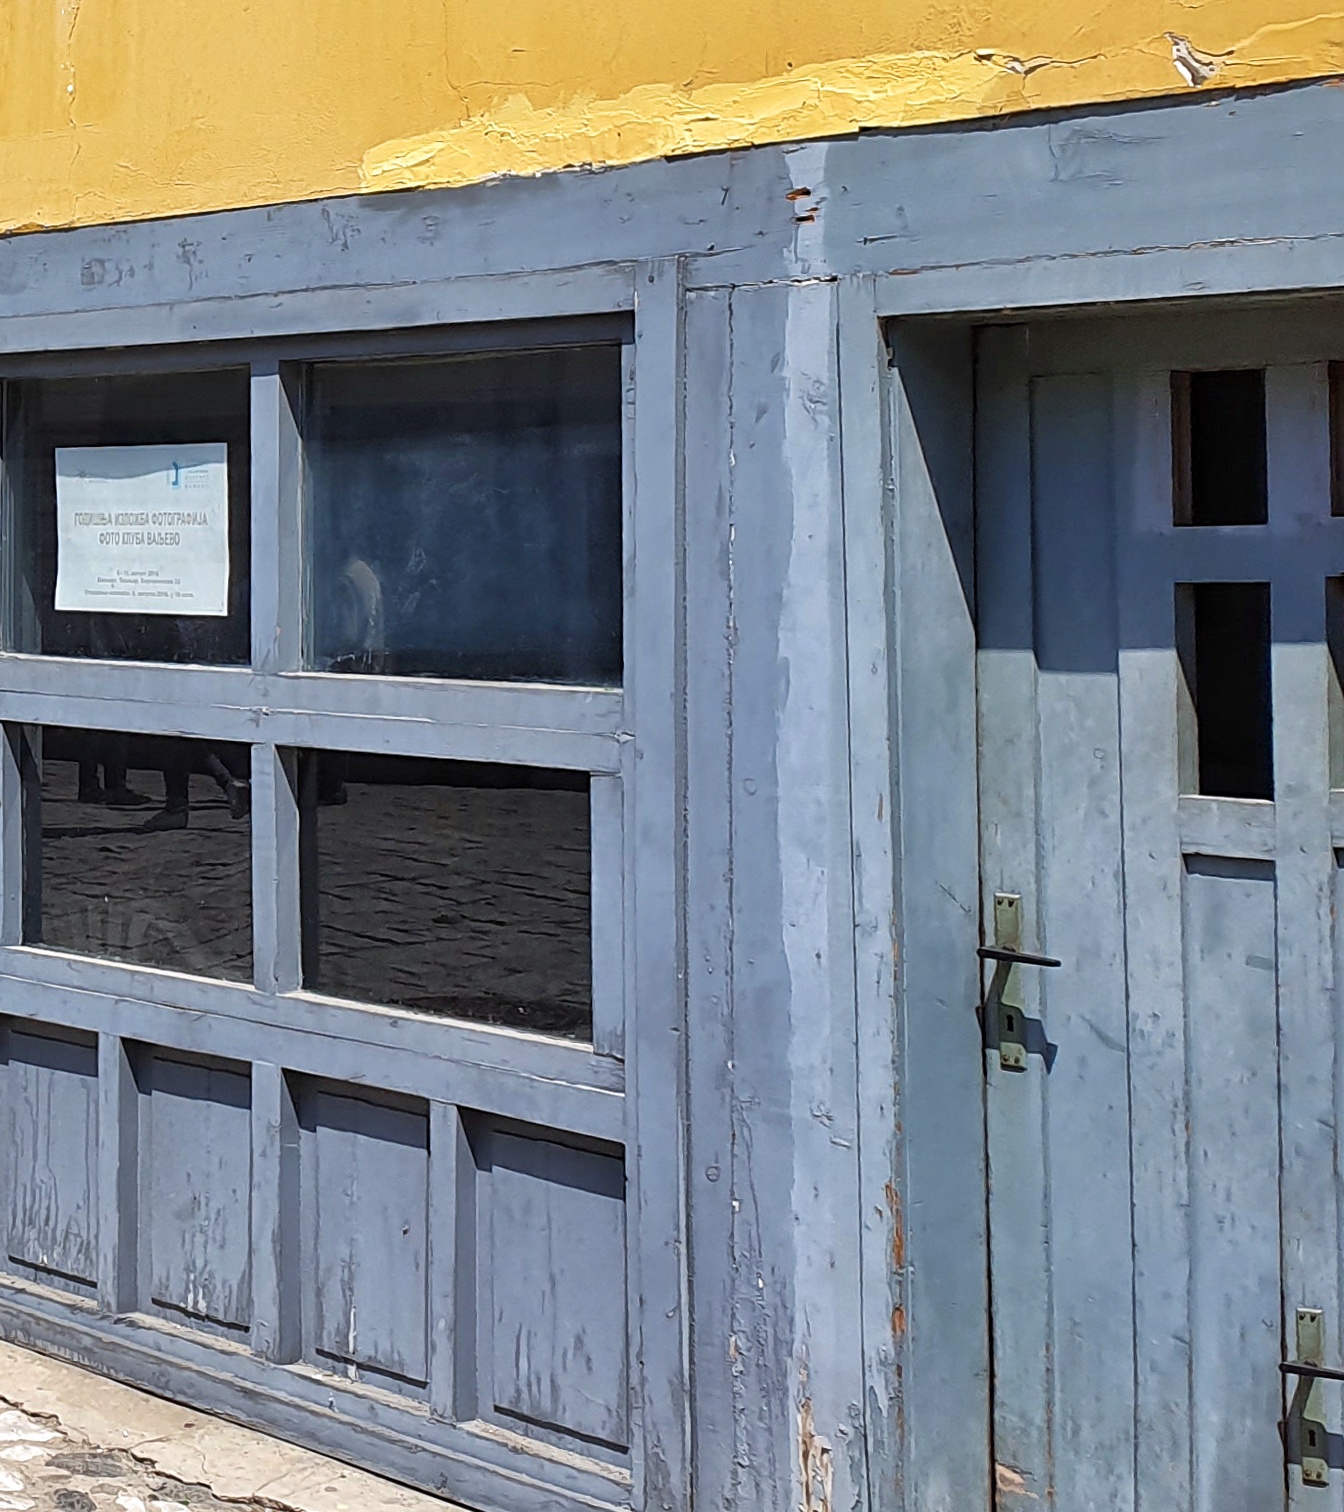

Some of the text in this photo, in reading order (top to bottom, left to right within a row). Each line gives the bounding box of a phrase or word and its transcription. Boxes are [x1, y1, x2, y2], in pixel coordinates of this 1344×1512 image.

[114, 512, 150, 527] ИЗЛОЖБА
[151, 512, 209, 527] ФОТОГРАФИЈА
[99, 531, 181, 546] ФОТО КЛУБА ВАЉЕВО
